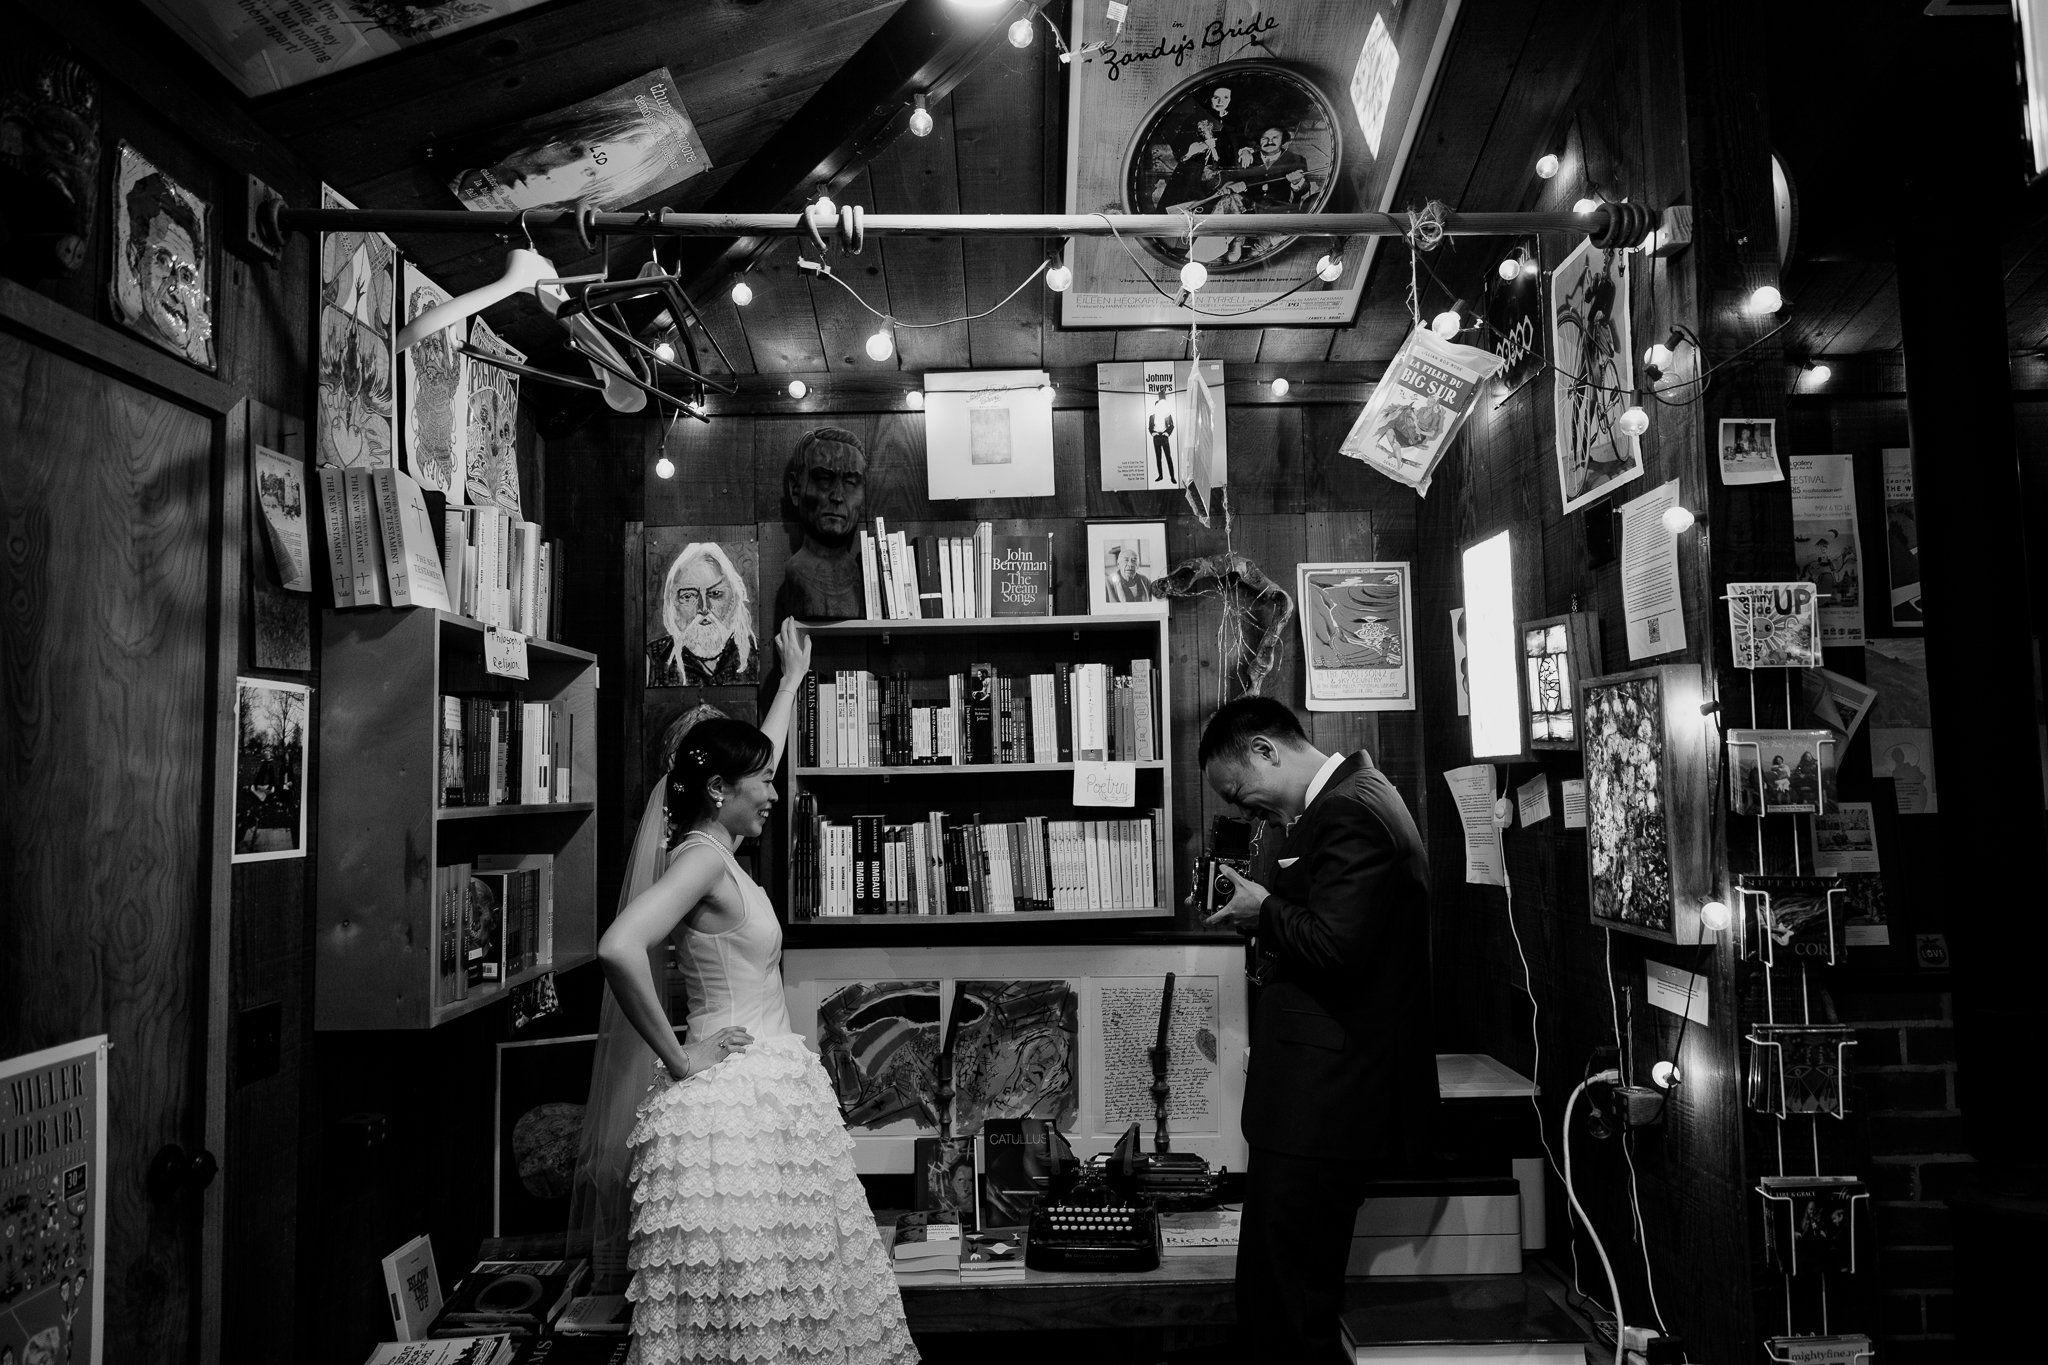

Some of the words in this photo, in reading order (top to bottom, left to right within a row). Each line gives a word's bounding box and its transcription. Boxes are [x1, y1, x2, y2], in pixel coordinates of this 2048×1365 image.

[318, 2, 339, 21] the
[264, 25, 304, 54] apart!
[314, 24, 341, 46] they
[292, 28, 332, 64] nothing
[1104, 34, 1194, 80] Zandy's
[1202, 12, 1280, 49] Bride
[589, 144, 608, 166] LSD
[656, 137, 680, 170] thoughts
[675, 132, 697, 163] moore
[1076, 296, 1110, 305] EILEEN
[1113, 296, 1160, 305] HECKART
[1207, 296, 1246, 304] TYRRELL
[1146, 372, 1173, 384] Johnny
[1408, 358, 1422, 370] LA
[1420, 364, 1449, 382] FILLE
[1448, 377, 1464, 390] DU
[1148, 383, 1173, 393] Rivers
[1400, 367, 1428, 390] BIG
[1425, 380, 1460, 406] SUR
[326, 476, 334, 493] THE
[350, 474, 358, 492] THE
[380, 476, 388, 493] THE
[1790, 476, 1826, 484] FESTIVAL
[329, 495, 338, 514] NEW
[352, 494, 361, 514] NEW
[383, 494, 392, 514] NEW
[332, 516, 343, 566] TESTAMENT
[354, 515, 365, 564] TESTAMENT
[386, 515, 399, 565] TESTAMENT
[992, 557, 1047, 574] Berryman
[1006, 547, 1032, 565] John
[1000, 581, 1038, 594] Dream
[1007, 571, 1031, 585] The
[1002, 592, 1036, 606] Songs
[1774, 588, 1811, 615] UP
[492, 656, 520, 671] Religion
[808, 675, 816, 708] POEMS
[1086, 773, 1129, 798] Poetry
[856, 861, 864, 899] RIMBAUD
[872, 861, 880, 898] RIMBAUD
[1920, 948, 1945, 958] LOVE
[11, 1064, 82, 1118] MILLER
[1, 1106, 82, 1169] LIBRARY
[989, 1133, 1048, 1146] CATULLUS
[406, 1265, 430, 1291] BLOW
[414, 1284, 430, 1301] ING
[416, 1300, 430, 1312] UP
